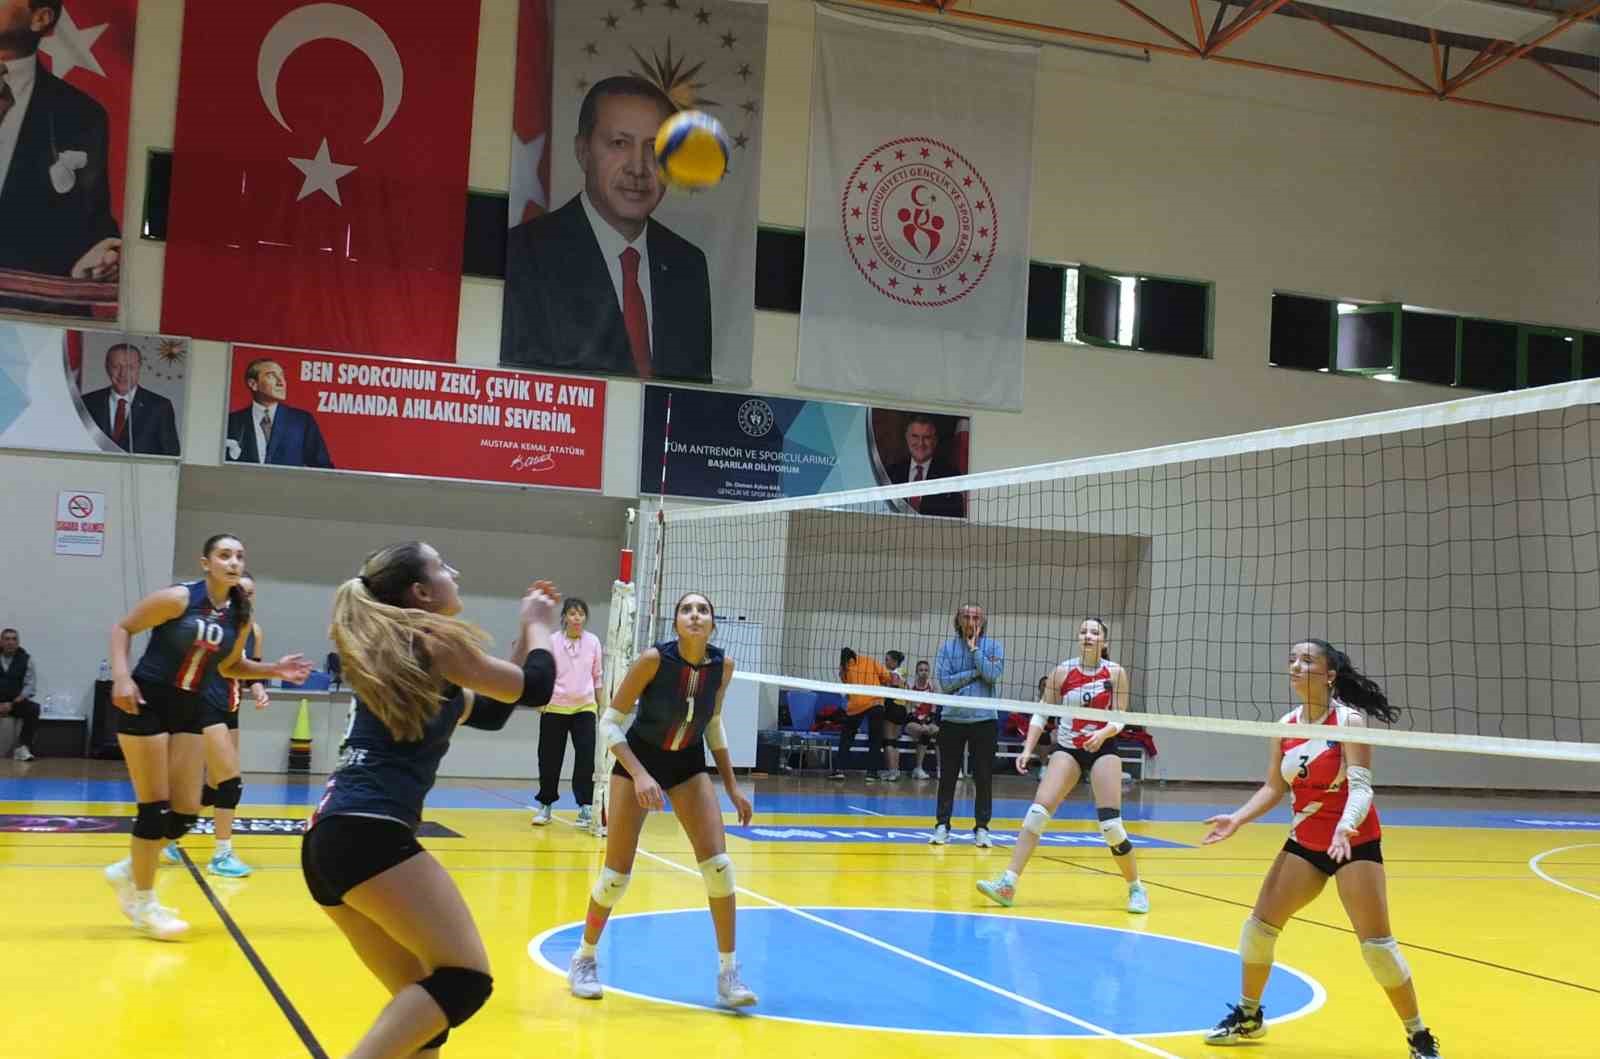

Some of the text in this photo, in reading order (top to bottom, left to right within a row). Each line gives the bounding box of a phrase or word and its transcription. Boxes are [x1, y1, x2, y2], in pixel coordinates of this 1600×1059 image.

[870, 171, 908, 231] CUMHURİYETİ
[909, 168, 950, 191] GENÇLİK
[949, 186, 962, 203] VE
[957, 202, 971, 230] SPOR
[300, 360, 595, 408] BEN SPORCUNUN ZEKİ, ÇEVİK VE AYNI
[317, 391, 576, 434] ZAMANDA AHLAKLISINI SEVERİM.
[480, 439, 585, 457] MUSTAFA KEMAL ATATÜRK
[689, 444, 742, 458] ANTRENÖR
[745, 448, 757, 459] VE
[708, 458, 800, 473] BAŞARILAR DİLİYORUM
[195, 618, 224, 645] 10
[686, 697, 694, 722] 1
[1297, 755, 1309, 779] 3
